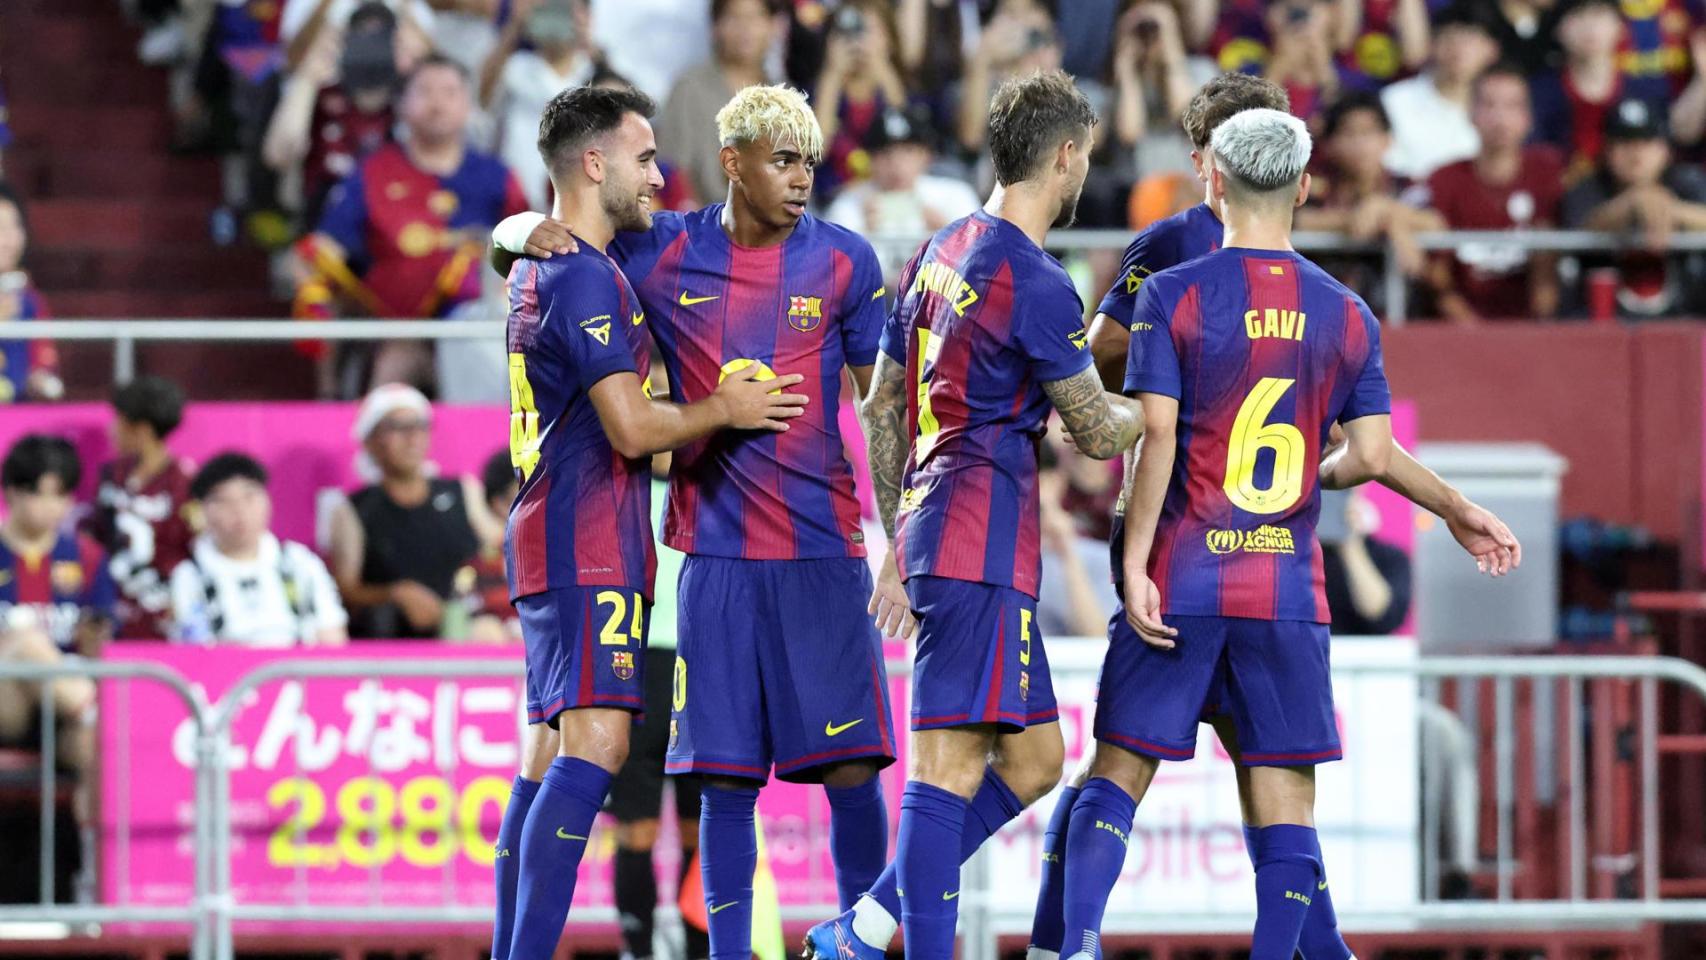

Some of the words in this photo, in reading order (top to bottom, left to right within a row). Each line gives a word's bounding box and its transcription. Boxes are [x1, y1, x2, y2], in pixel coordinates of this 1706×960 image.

[1244, 308, 1306, 341] GAVI
[1223, 377, 1305, 514] 6
[1243, 535, 1295, 549] ACNUR
[1020, 607, 1032, 667] 5
[172, 680, 524, 772] どんなに
